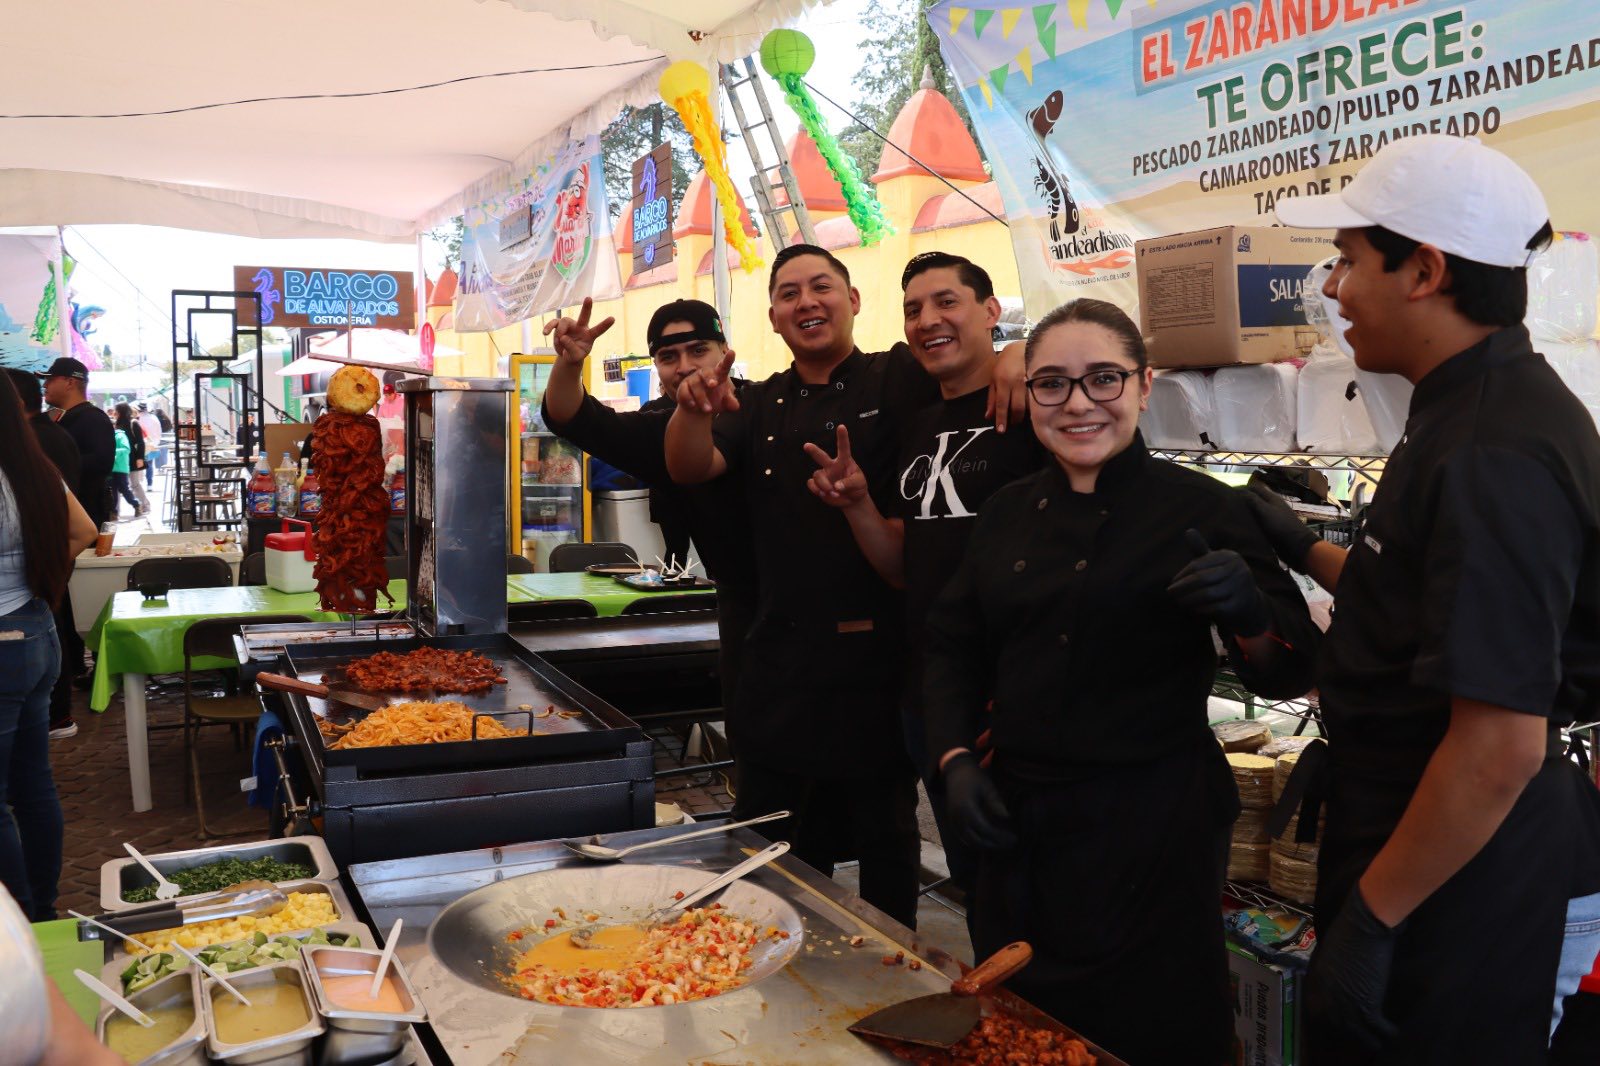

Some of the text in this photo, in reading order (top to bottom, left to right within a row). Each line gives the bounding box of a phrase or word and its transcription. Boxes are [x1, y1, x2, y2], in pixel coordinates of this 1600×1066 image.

[1143, 34, 1174, 83] EL
[1197, 10, 1483, 128] TE OFRECE:
[1133, 140, 1201, 176] PESCADO
[1199, 144, 1321, 192] CAMAROONES
[634, 196, 668, 231] BARCO
[1149, 238, 1213, 254] ESTE LADO HACIA ARRIBA
[283, 271, 398, 300] BARCO
[285, 300, 399, 316] DE ALVARADOS
